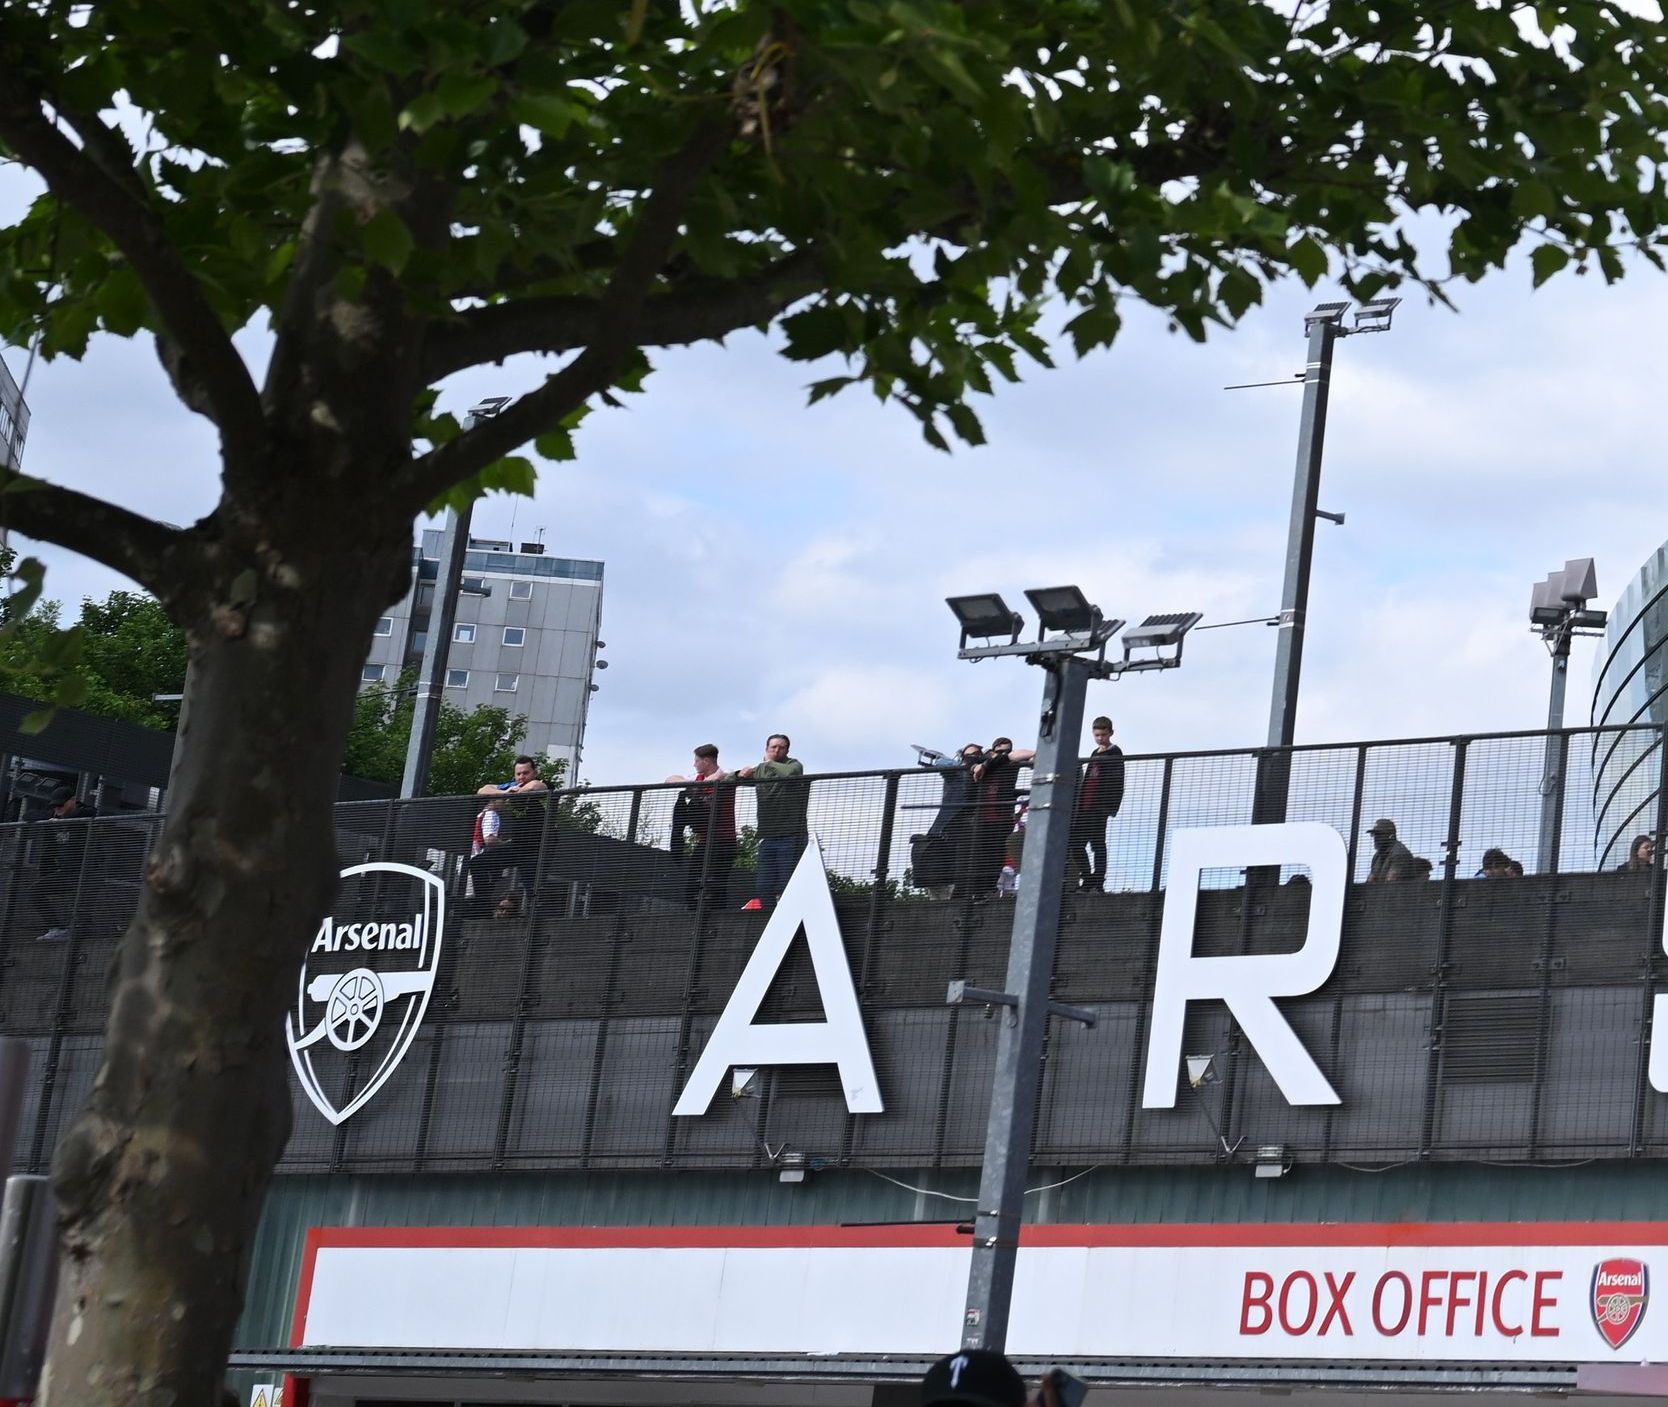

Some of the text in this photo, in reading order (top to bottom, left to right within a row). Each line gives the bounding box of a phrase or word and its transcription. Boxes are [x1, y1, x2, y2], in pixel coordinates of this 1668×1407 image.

[310, 913, 424, 953] Arsenal
[1598, 1271, 1642, 1287] Arsenal
[1238, 1269, 1564, 1338] BOX OFFICE
